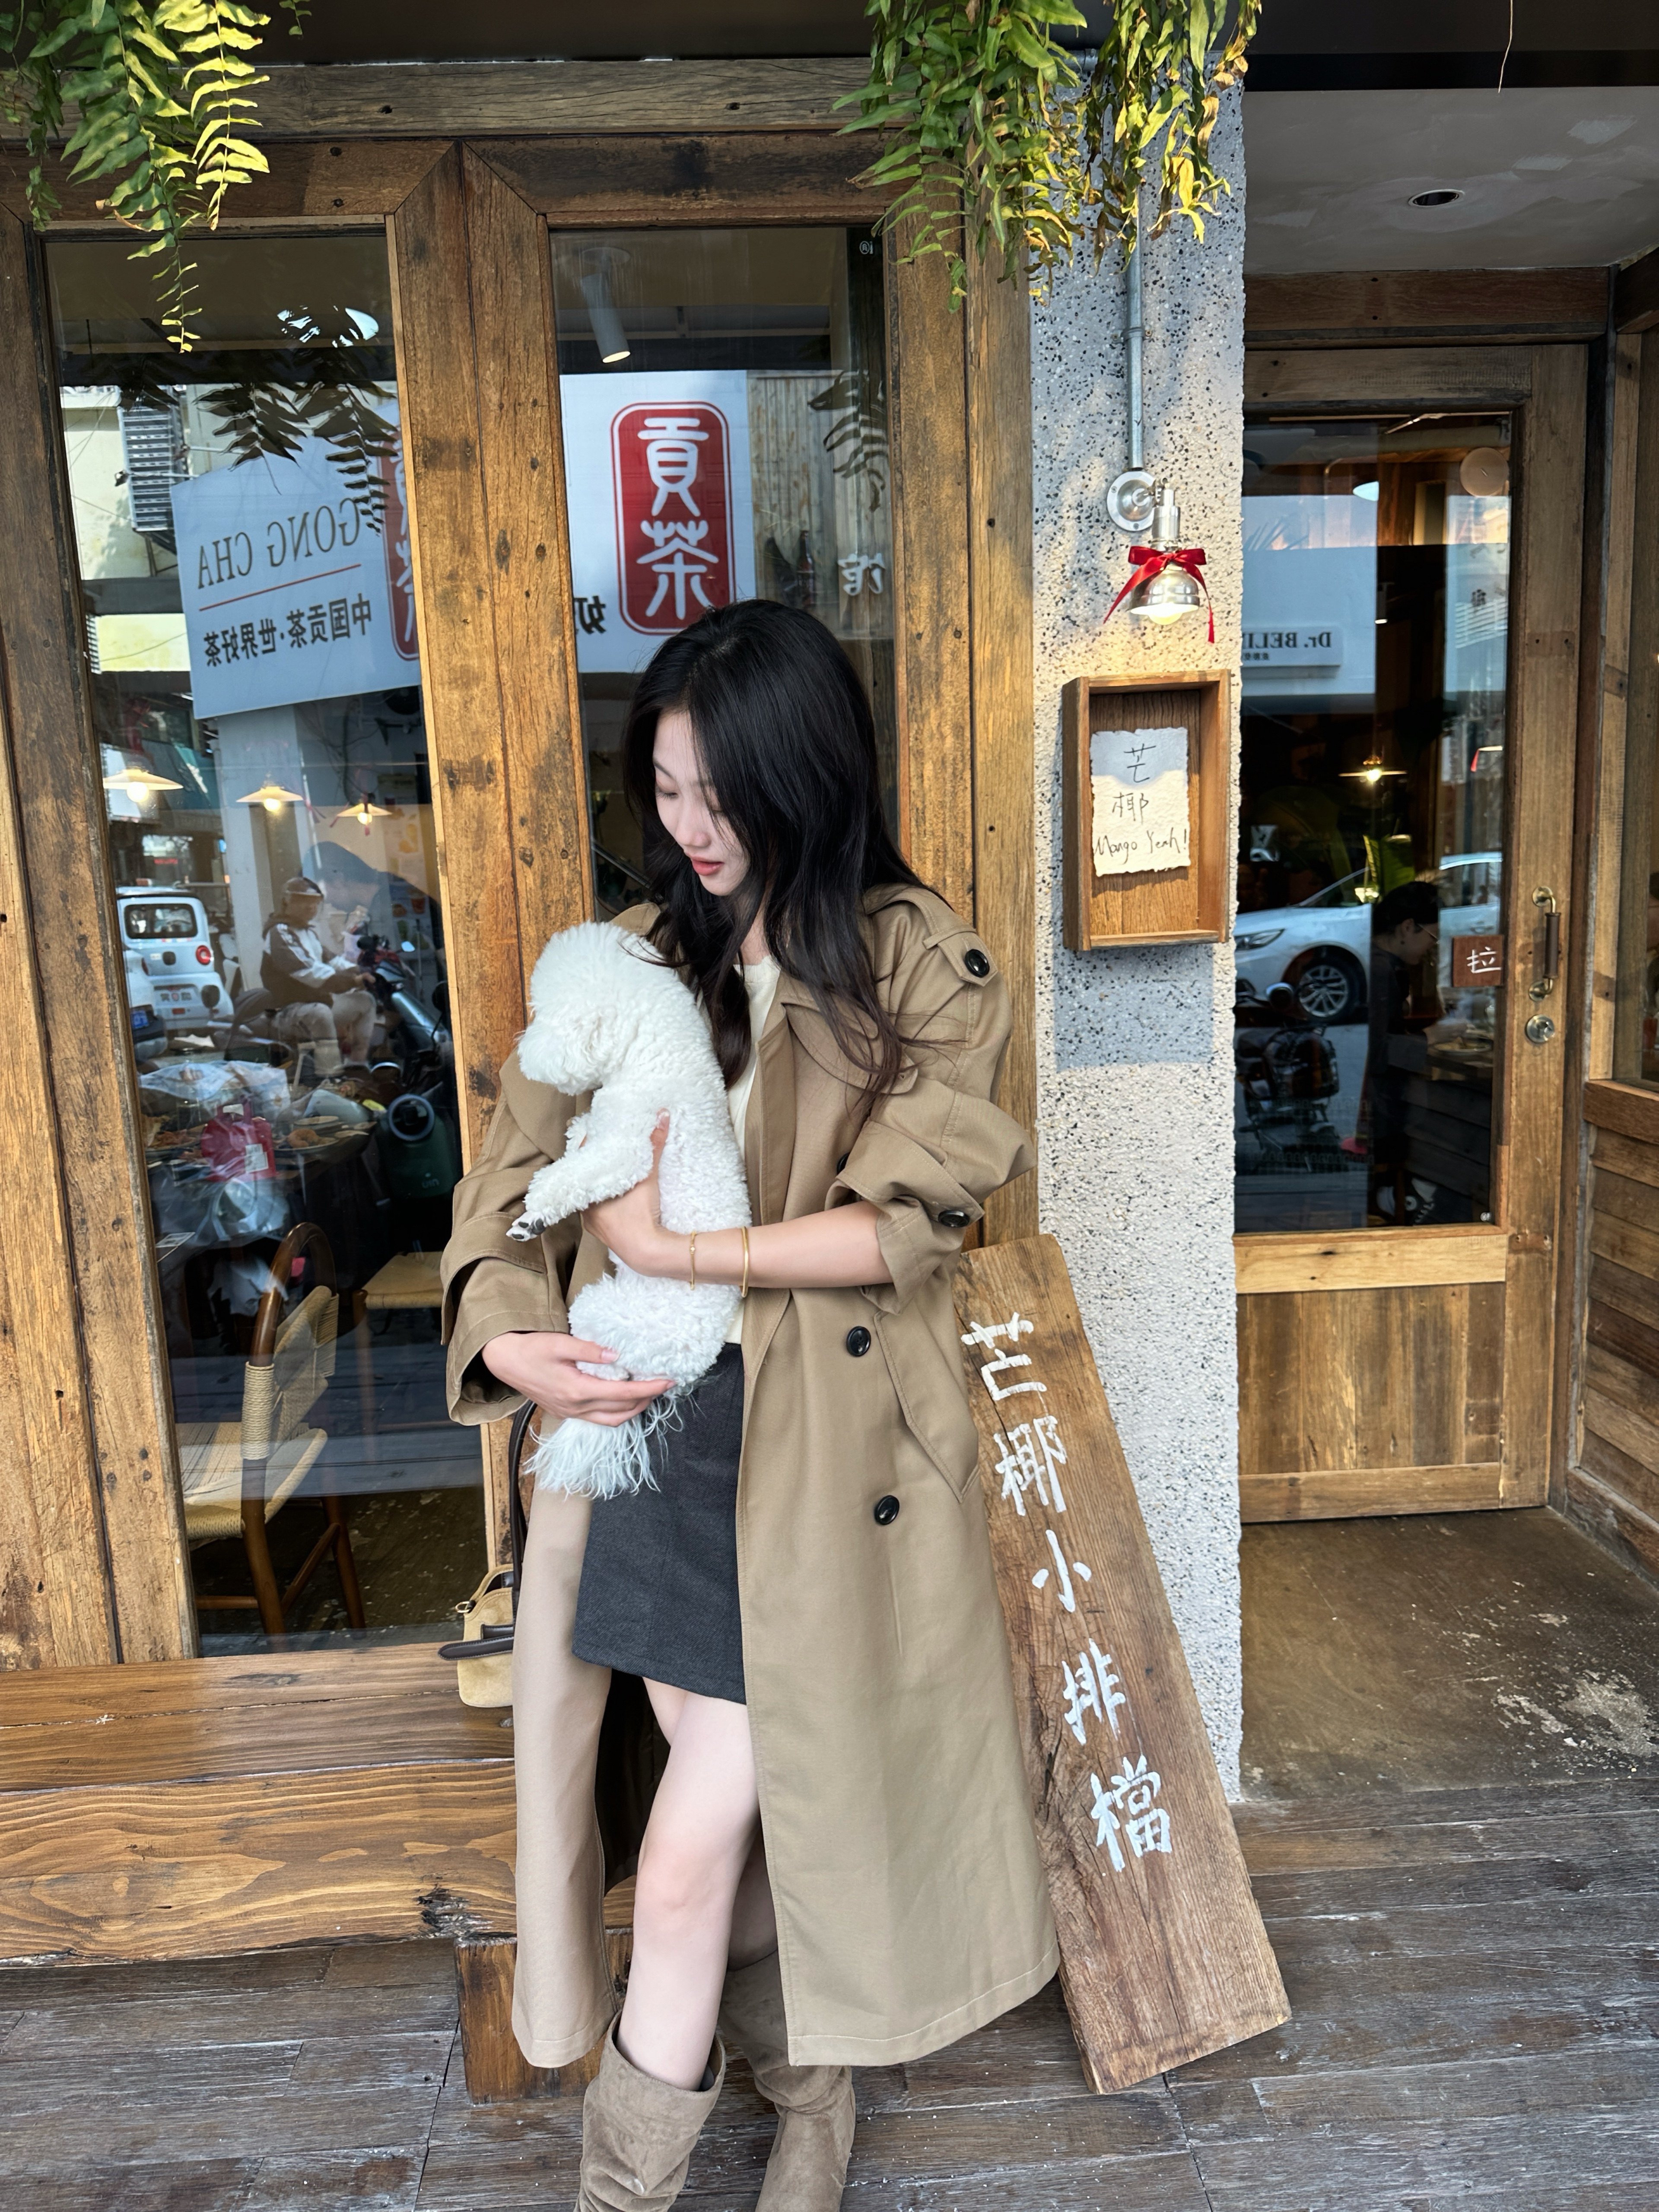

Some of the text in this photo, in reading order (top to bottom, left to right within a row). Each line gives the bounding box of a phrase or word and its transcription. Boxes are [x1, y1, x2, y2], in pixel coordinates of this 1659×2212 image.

[1094, 827, 1186, 865] Mango Yeah!
[1467, 947, 1502, 973] 拉
[961, 1312, 1172, 1872] 芒椰小排檔
